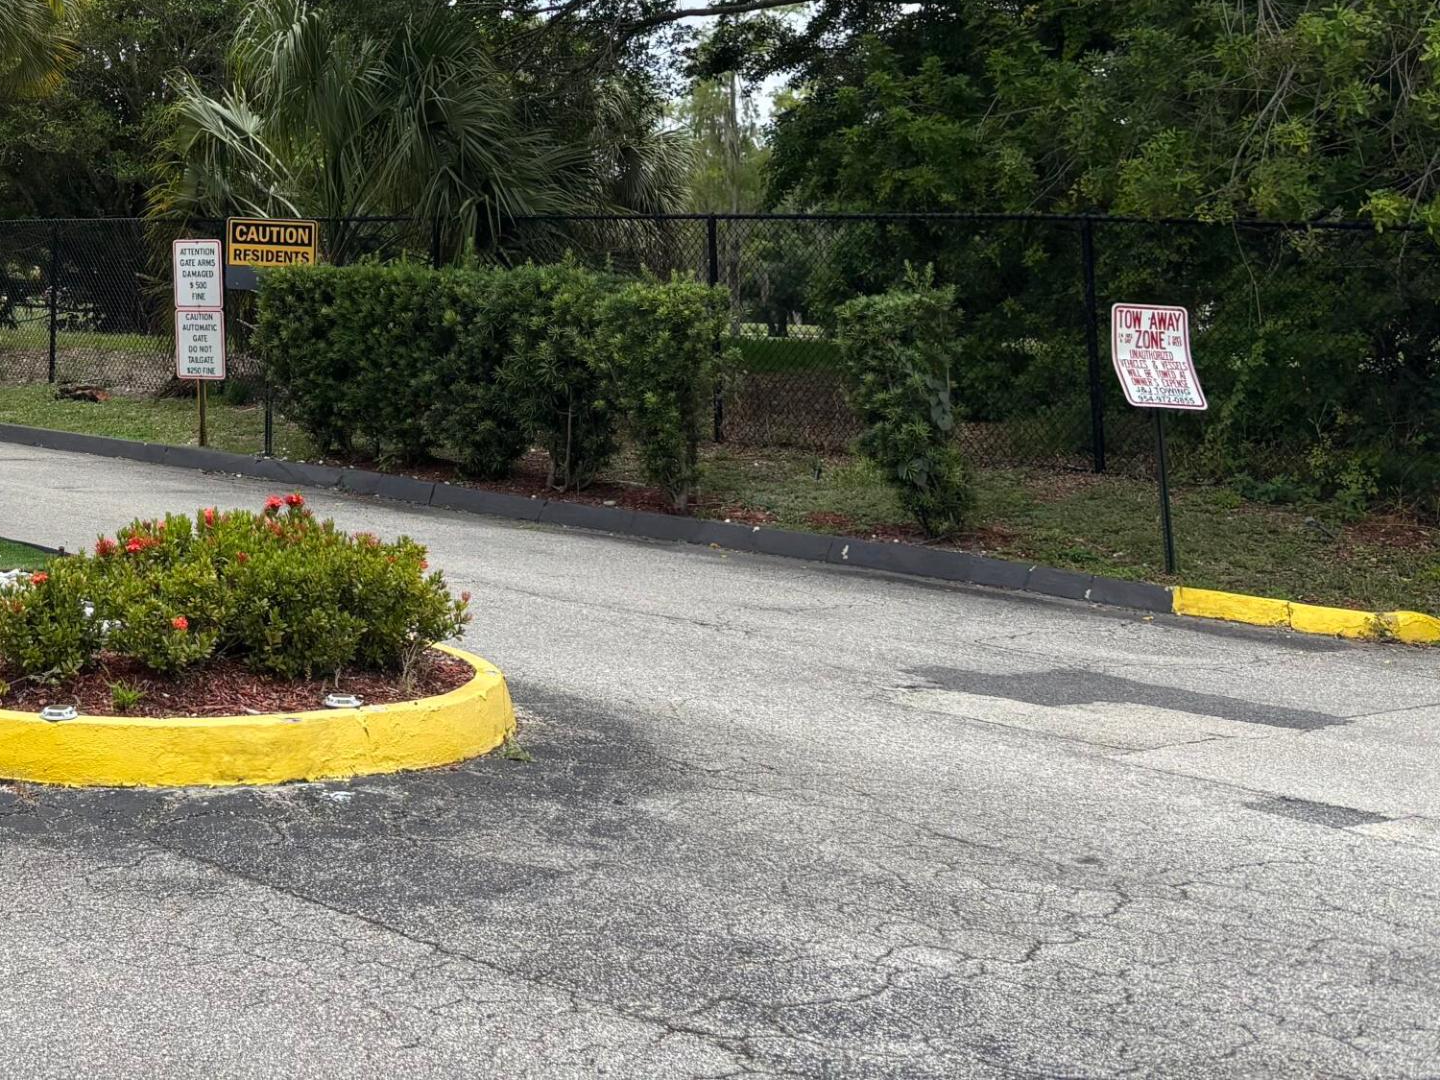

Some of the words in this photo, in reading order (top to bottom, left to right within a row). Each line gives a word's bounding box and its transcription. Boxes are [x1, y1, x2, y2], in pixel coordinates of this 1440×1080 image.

[235, 225, 309, 244] CAUTION
[180, 248, 215, 256] ATTENTION
[233, 248, 310, 263] RESIDENTS
[179, 259, 196, 267] GATE
[197, 259, 216, 267] ARMS
[182, 270, 214, 278] DAMAGED
[191, 292, 206, 301] FINE
[185, 313, 213, 321] CAUTION
[1118, 309, 1142, 330] TOW
[1149, 311, 1181, 332] AWAY
[1135, 330, 1166, 350] ZONE
[188, 345, 198, 353] DO
[199, 345, 212, 353] NOT
[188, 356, 214, 364] TAILGATE
[1120, 359, 1148, 370] VEHICLES
